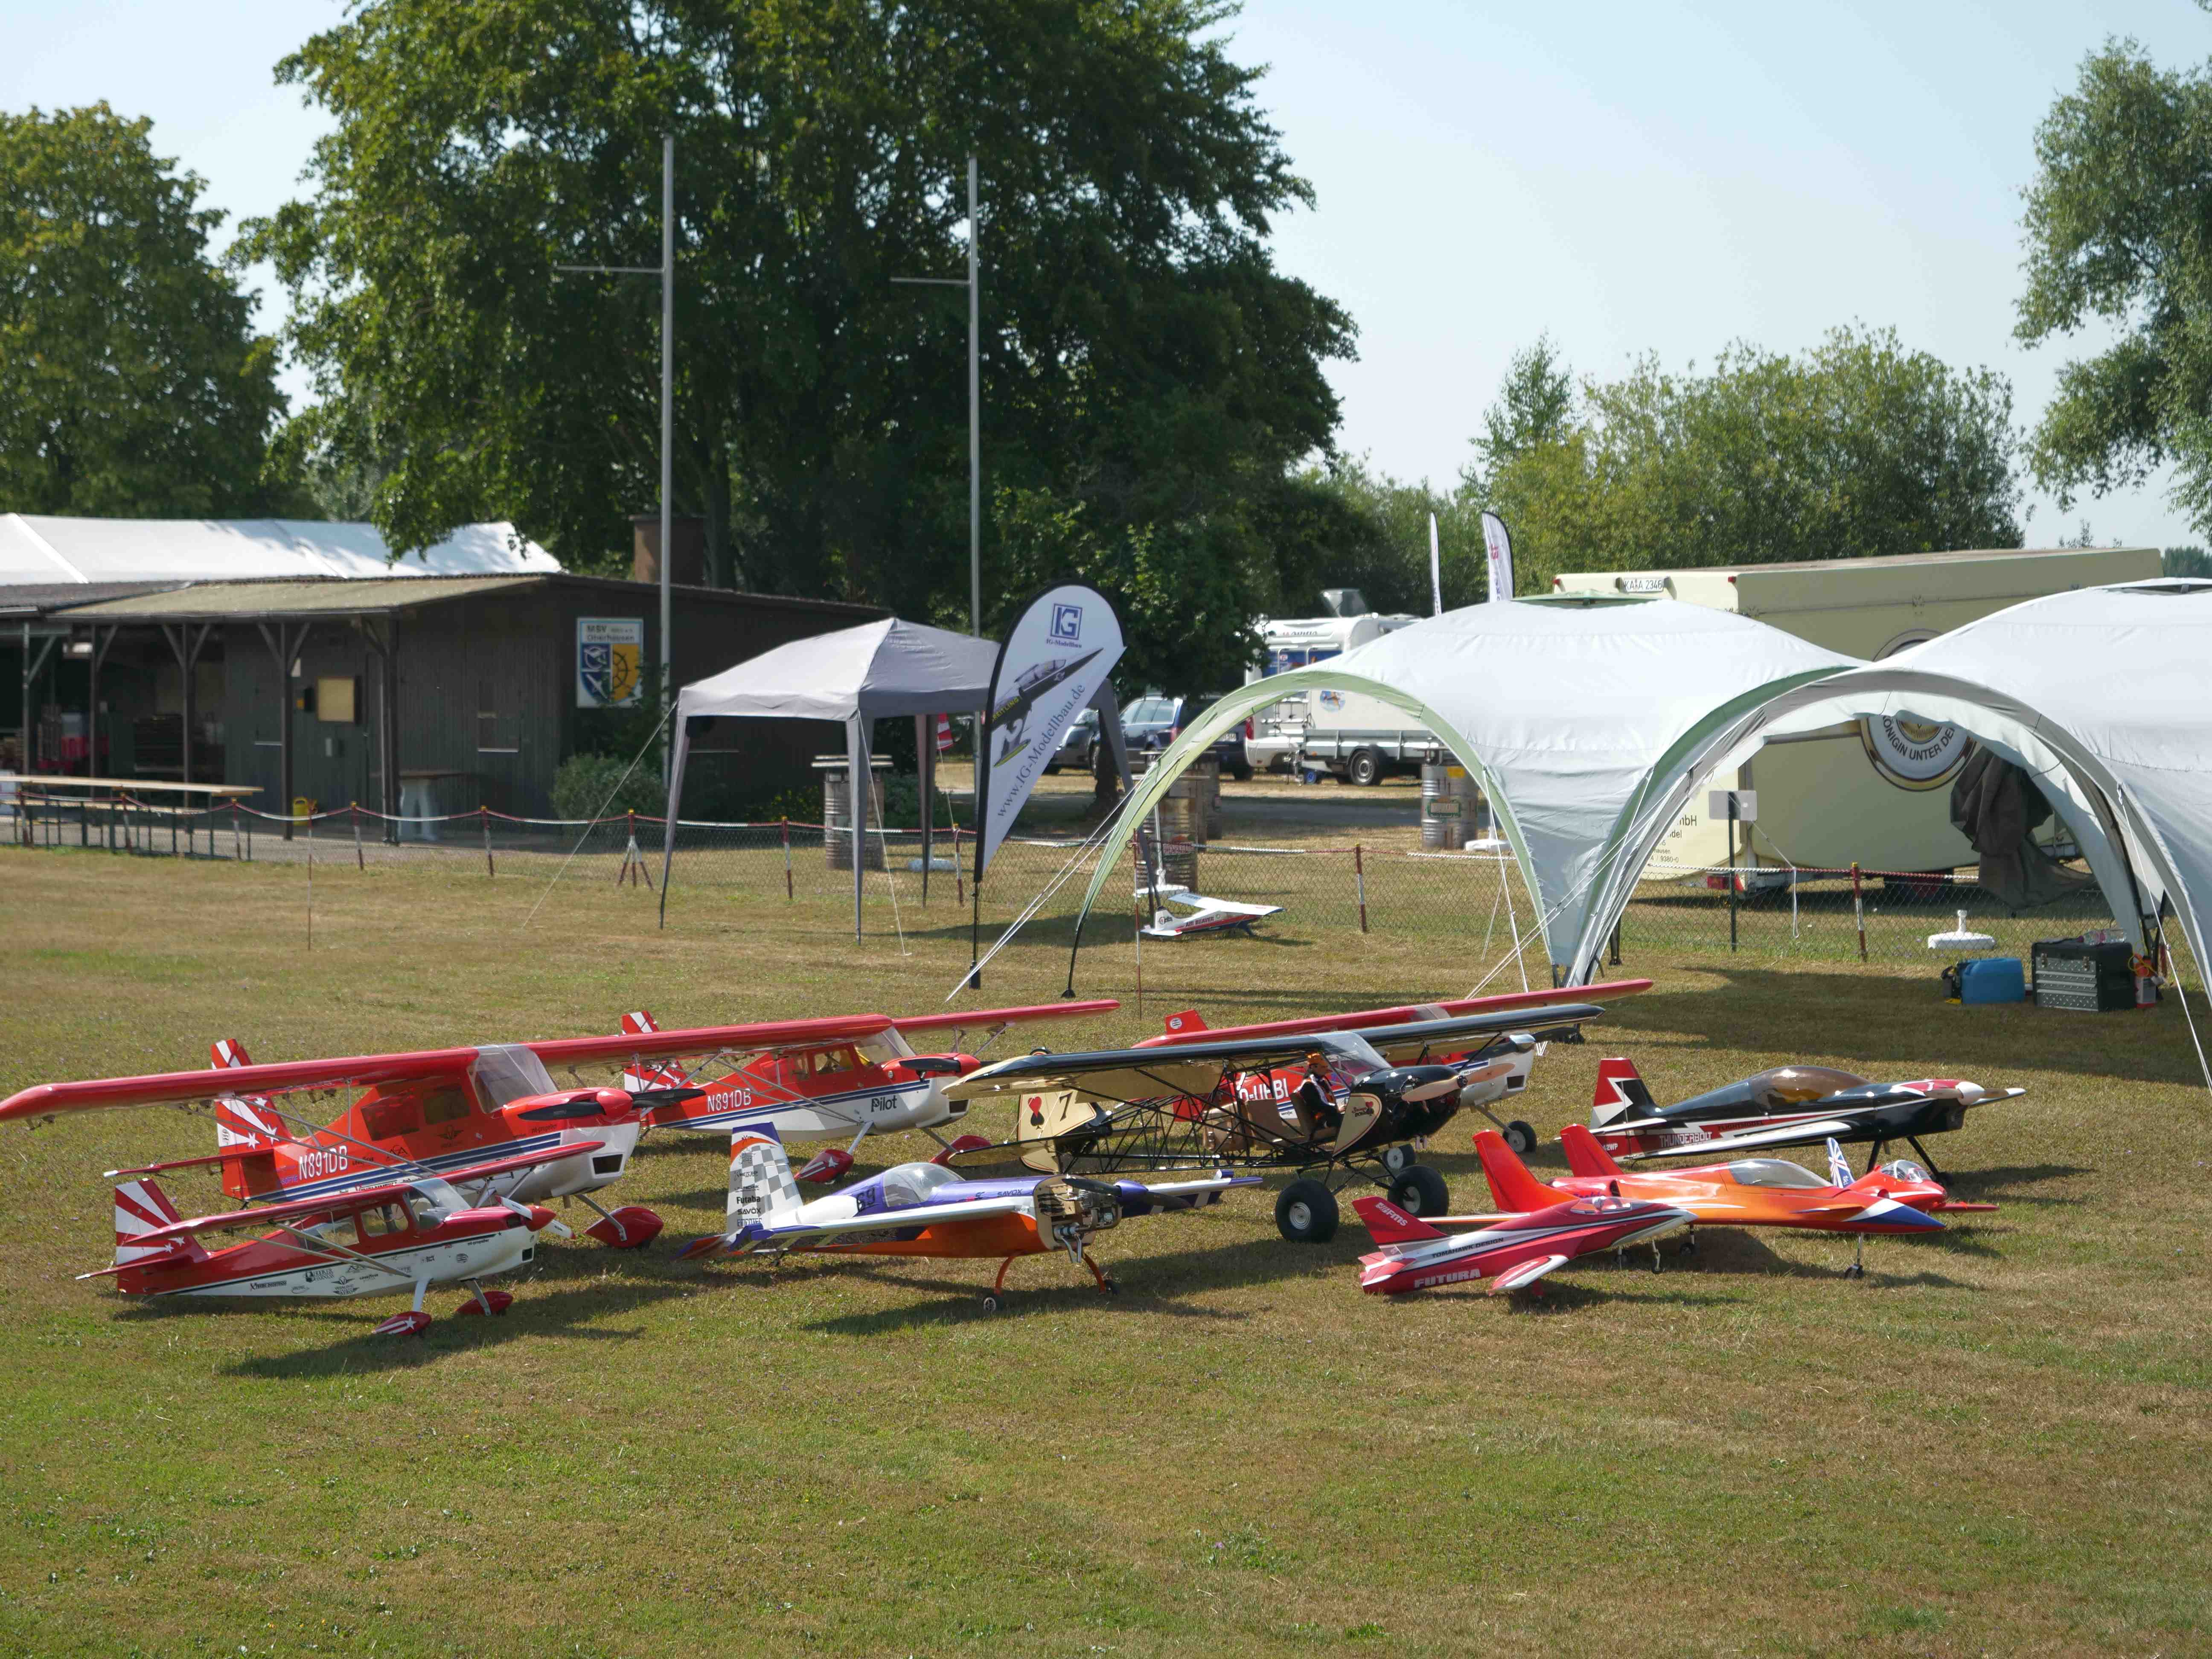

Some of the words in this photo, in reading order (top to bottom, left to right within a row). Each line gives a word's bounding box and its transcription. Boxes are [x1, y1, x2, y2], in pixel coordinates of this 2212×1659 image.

[1646, 580, 1662, 590] 2346
[1055, 607, 1079, 636] IG
[1046, 638, 1082, 648] IG-Modellbau
[998, 684, 1086, 817] www.IG-Modellbau.de
[1909, 743, 1941, 761] UNTER
[1941, 727, 1955, 748] DE
[707, 1088, 751, 1113] N891DB
[871, 1095, 897, 1112] Pilot
[1059, 1091, 1073, 1122] 7
[1659, 1131, 1712, 1147] THUNDERBOLT
[299, 1145, 348, 1180] N891DB
[736, 1195, 761, 1204] Futaba
[1432, 1244, 1474, 1258] TOMAHAWK
[1476, 1237, 1504, 1249] DESIGN
[1415, 1268, 1481, 1289] FUTURA
